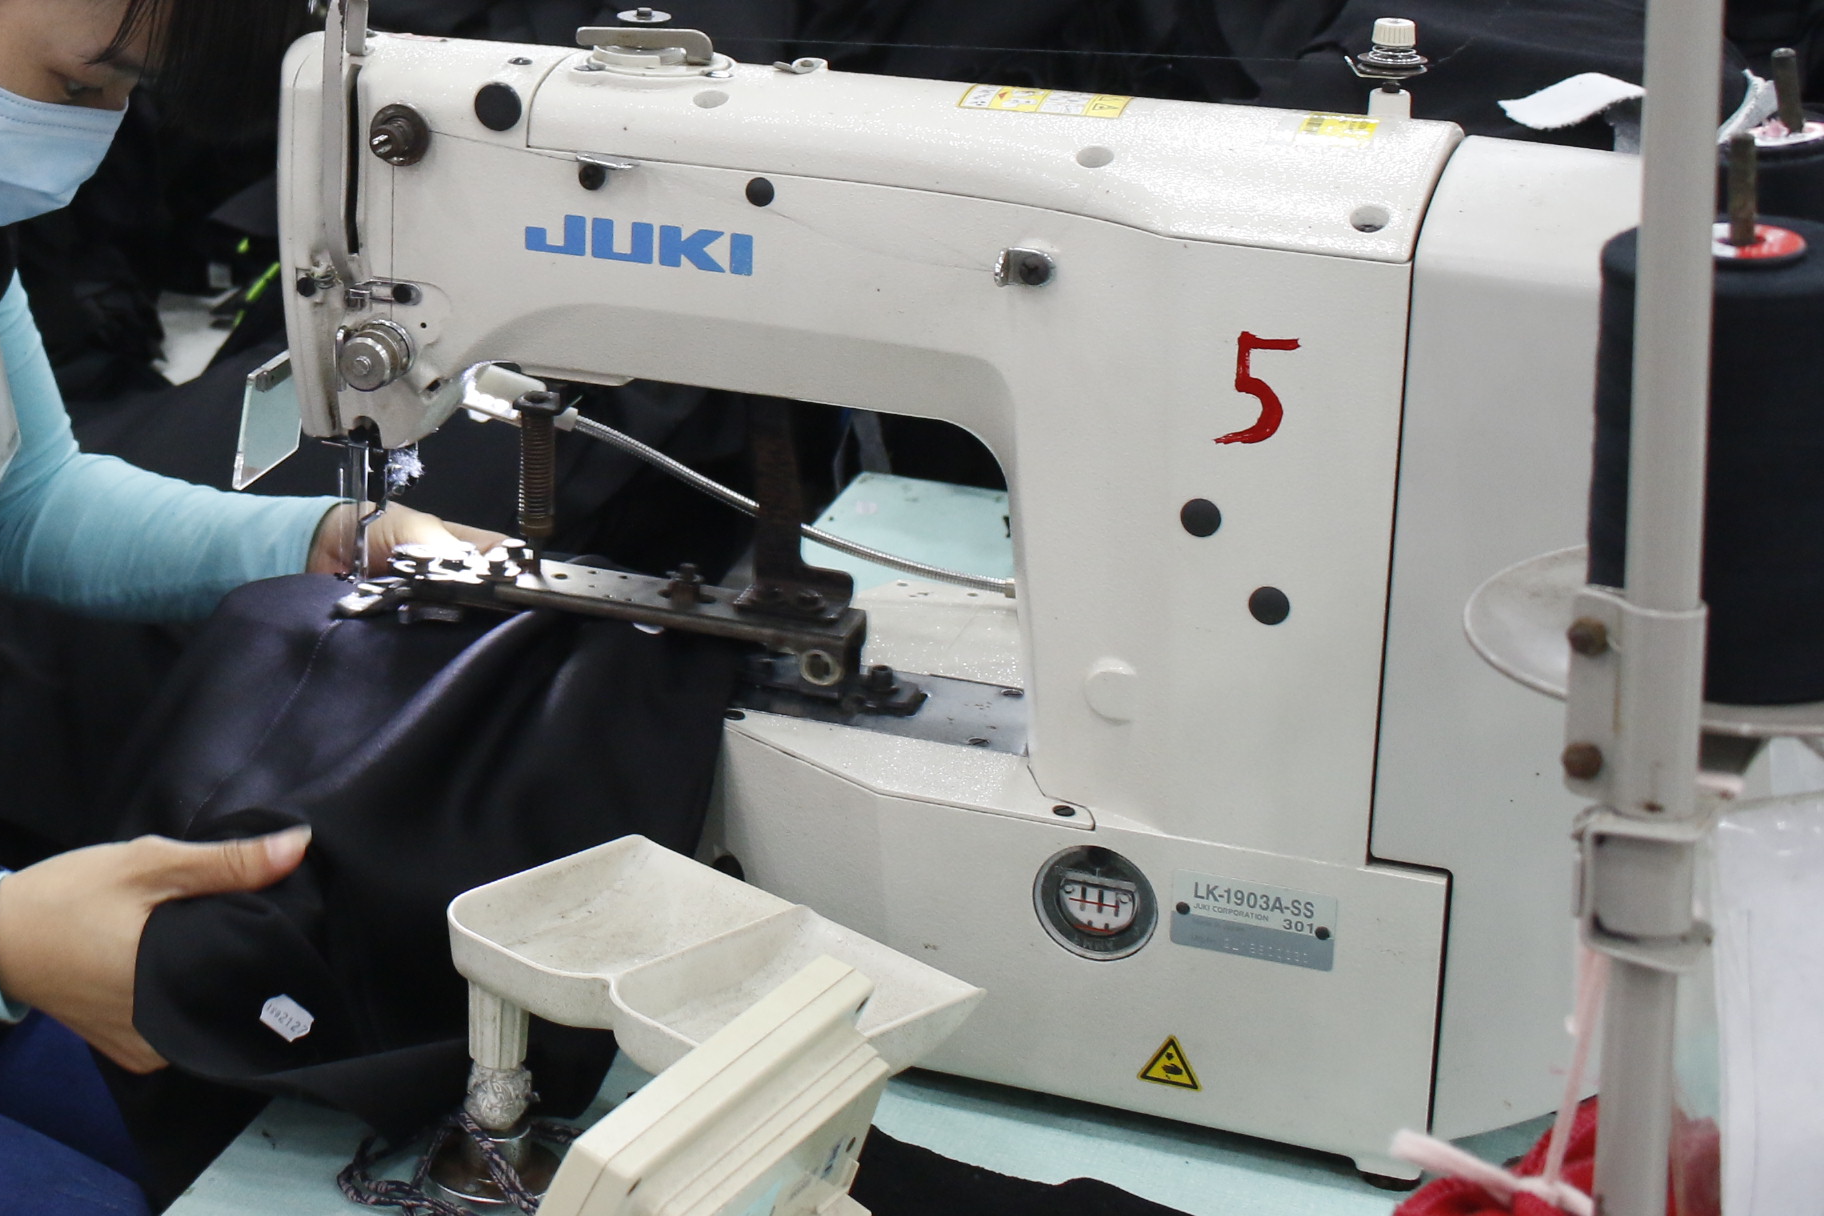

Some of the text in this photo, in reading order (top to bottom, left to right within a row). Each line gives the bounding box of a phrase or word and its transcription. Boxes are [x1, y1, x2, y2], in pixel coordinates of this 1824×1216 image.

[524, 214, 754, 277] JUKI
[1213, 330, 1302, 446] 5
[1192, 902, 1270, 923] JUKI CORPORATION
[1194, 882, 1315, 919] LK-1903A-SS
[1282, 918, 1315, 935] 301
